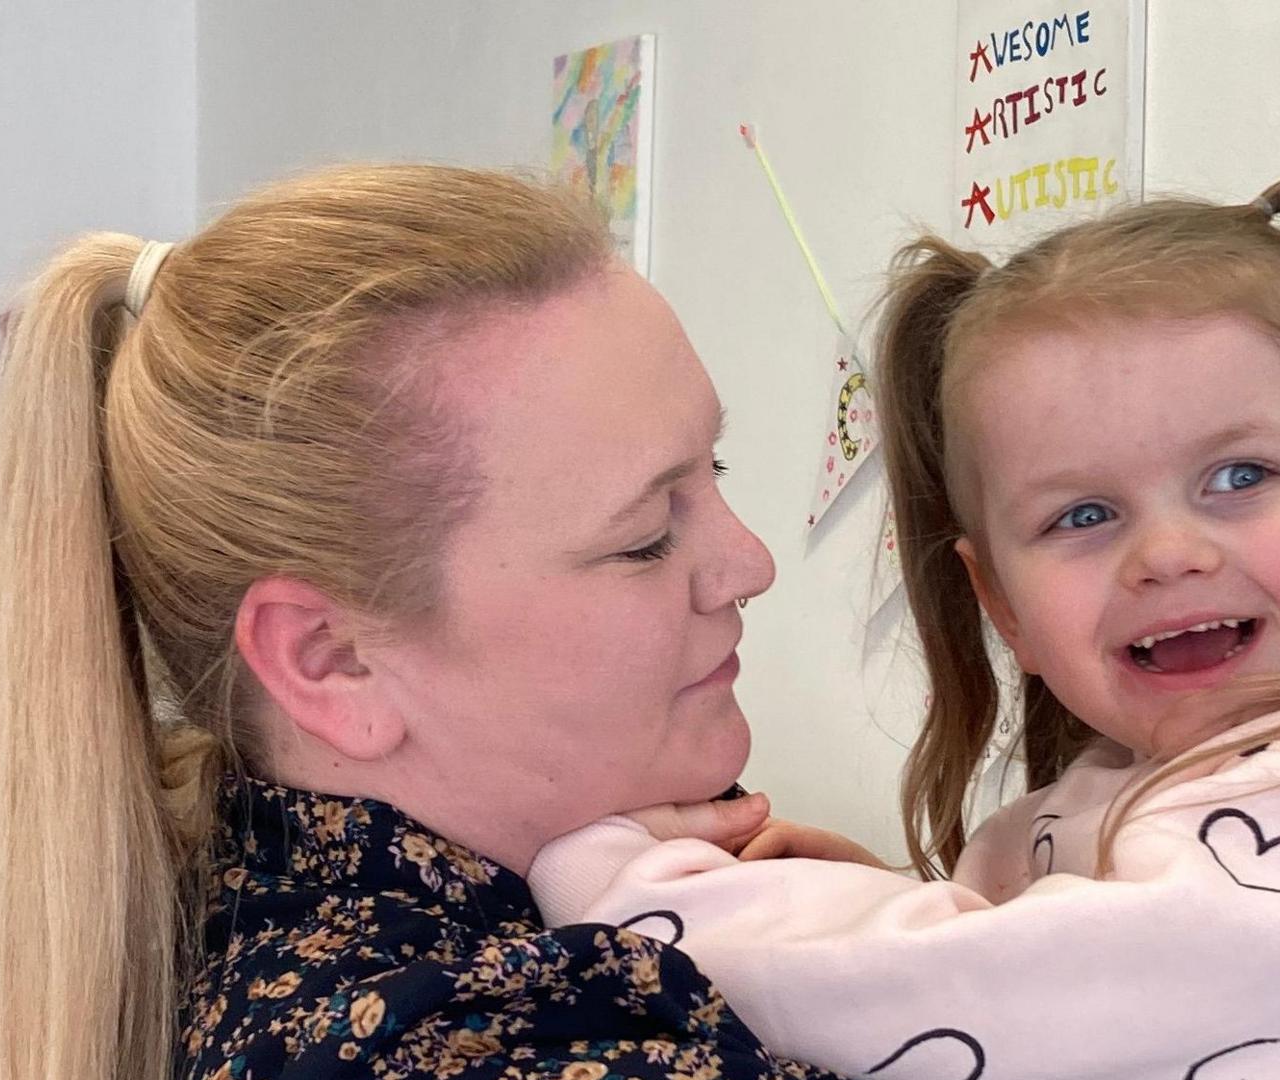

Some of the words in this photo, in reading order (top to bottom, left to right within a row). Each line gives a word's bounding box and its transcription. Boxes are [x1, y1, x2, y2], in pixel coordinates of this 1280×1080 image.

[970, 11, 1090, 83] AWESOME
[965, 68, 1107, 153] ARTISTIC
[961, 157, 1118, 229] AUTISTIC
